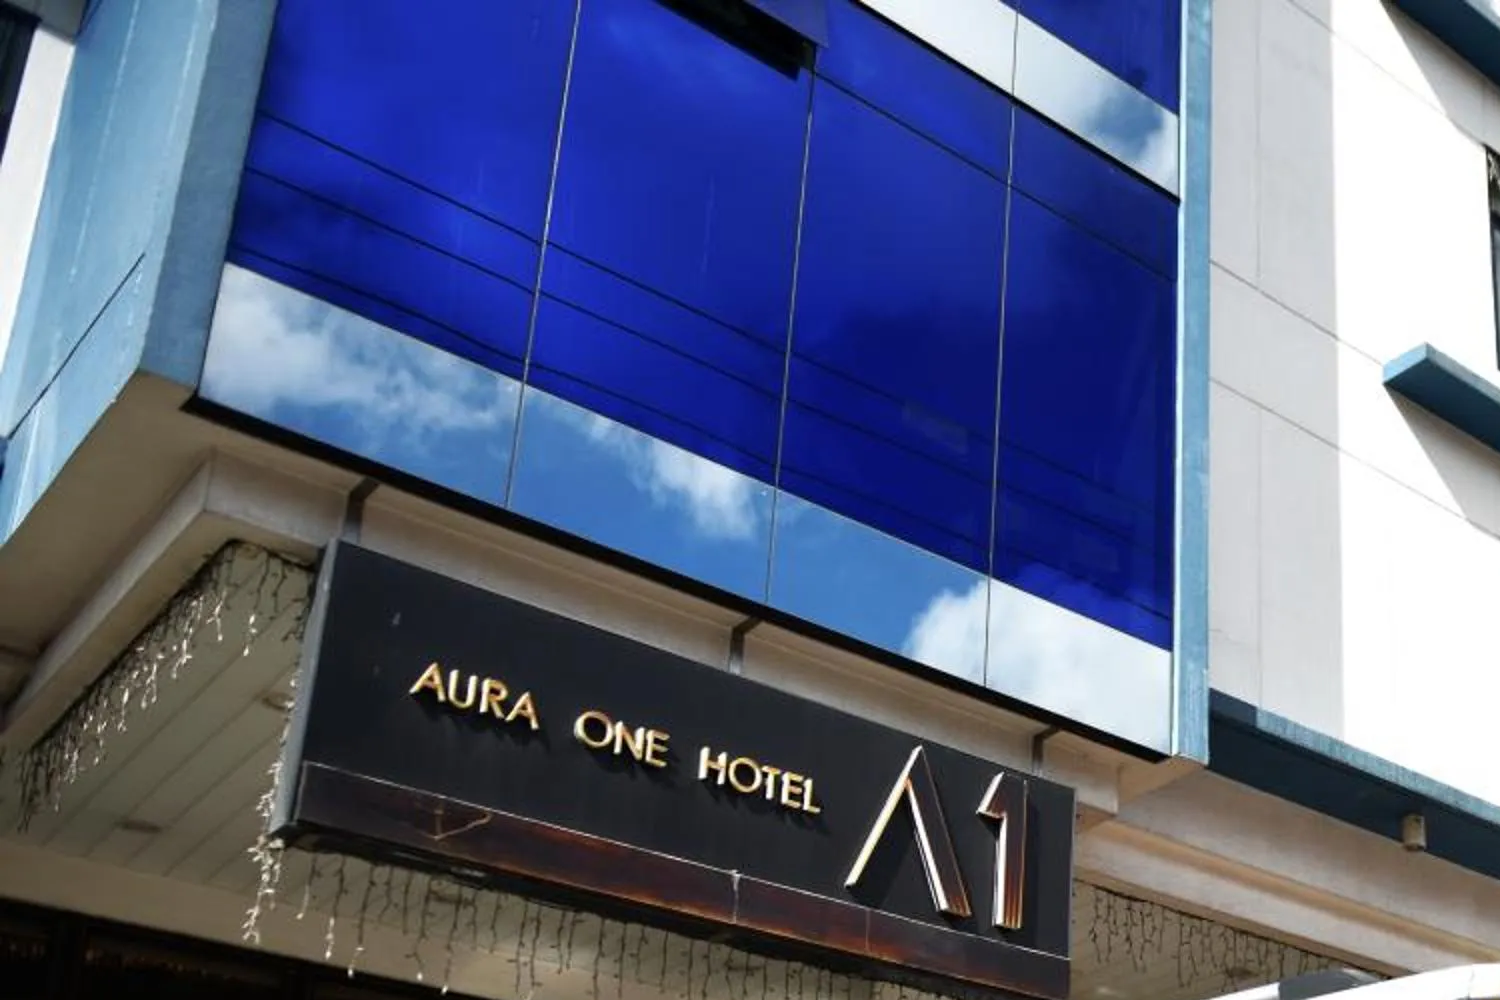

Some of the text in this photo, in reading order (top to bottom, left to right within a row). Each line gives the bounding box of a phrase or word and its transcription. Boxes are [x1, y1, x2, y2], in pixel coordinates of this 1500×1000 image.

[408, 662, 822, 816] AURA ONE HOTEL
